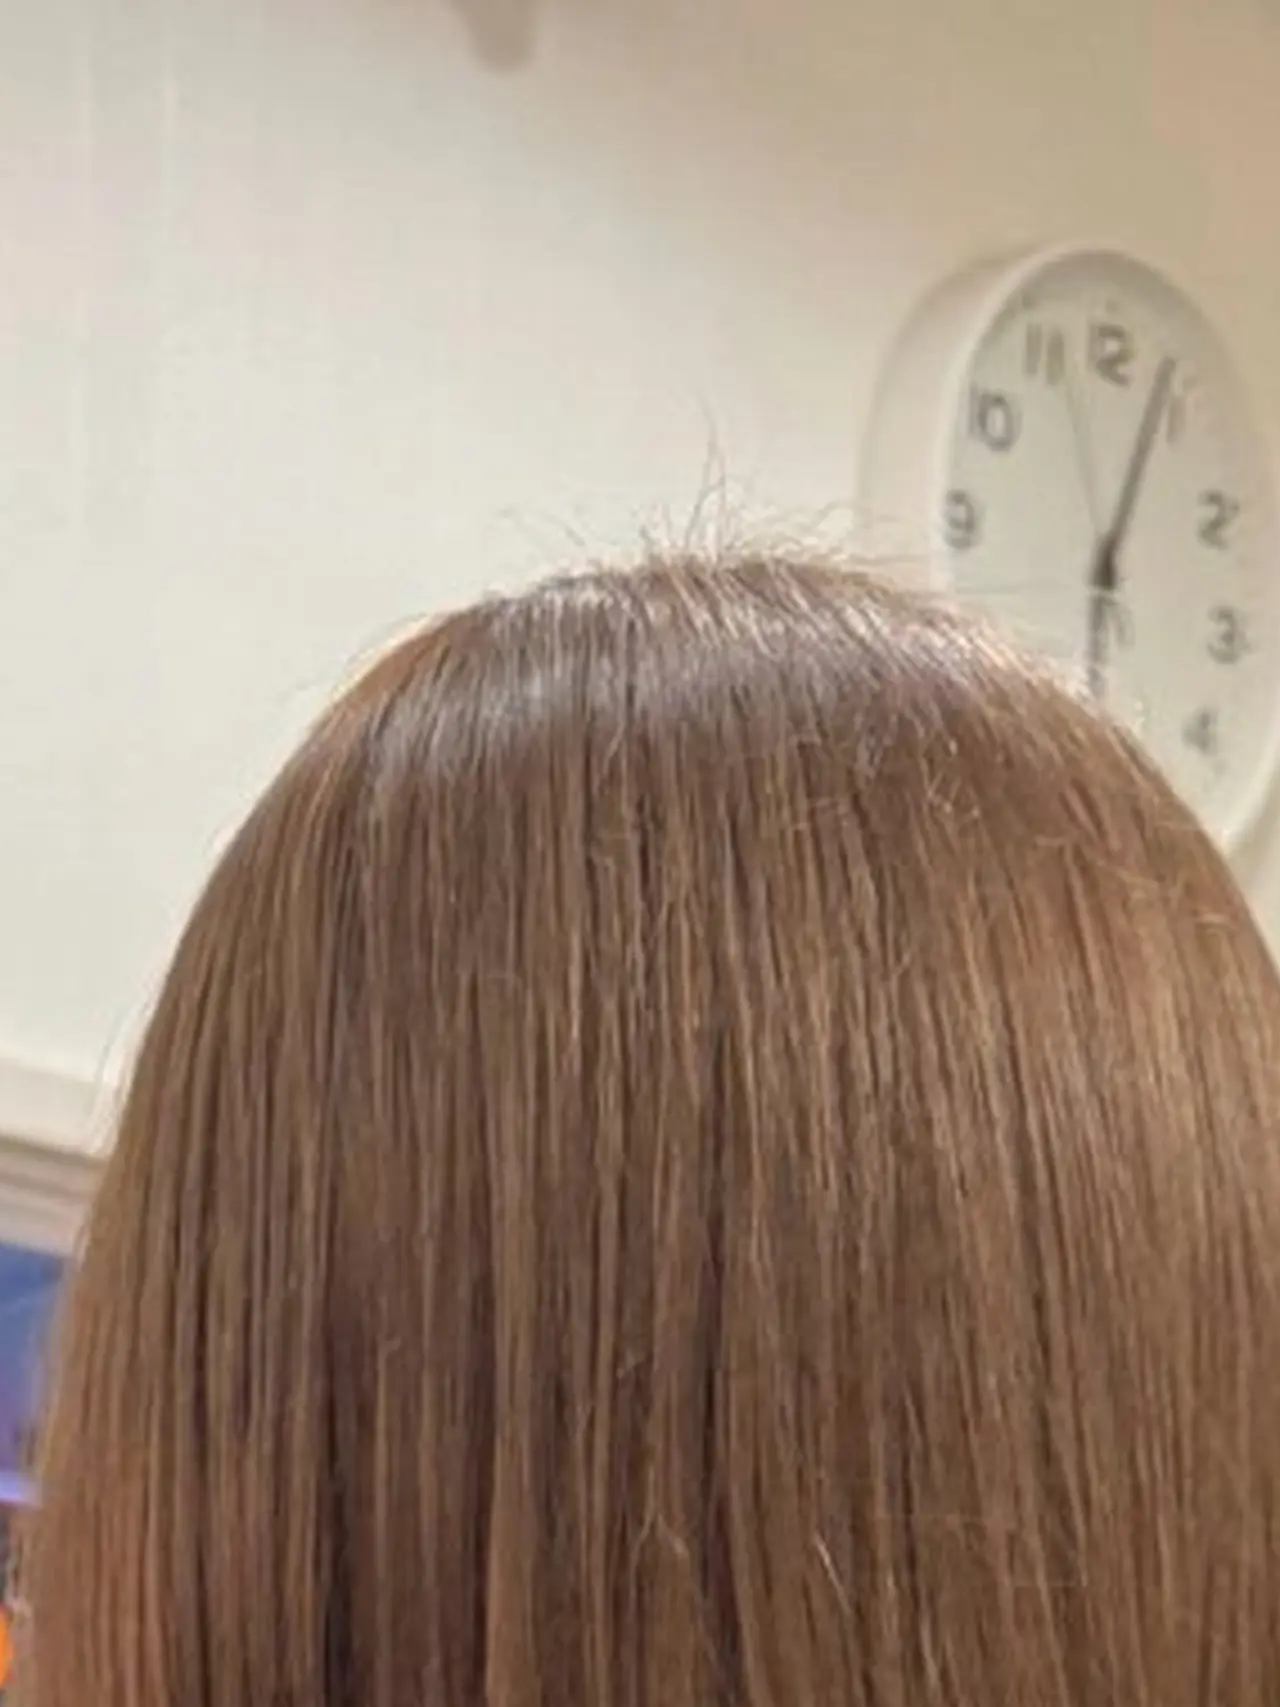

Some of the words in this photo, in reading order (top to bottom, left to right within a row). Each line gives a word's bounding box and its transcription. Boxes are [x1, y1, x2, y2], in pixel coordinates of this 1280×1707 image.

[1025, 322, 1065, 386] 11
[1086, 322, 1132, 387] 12
[943, 488, 980, 549] 9
[1197, 490, 1240, 549] 2
[1207, 604, 1249, 664] 3
